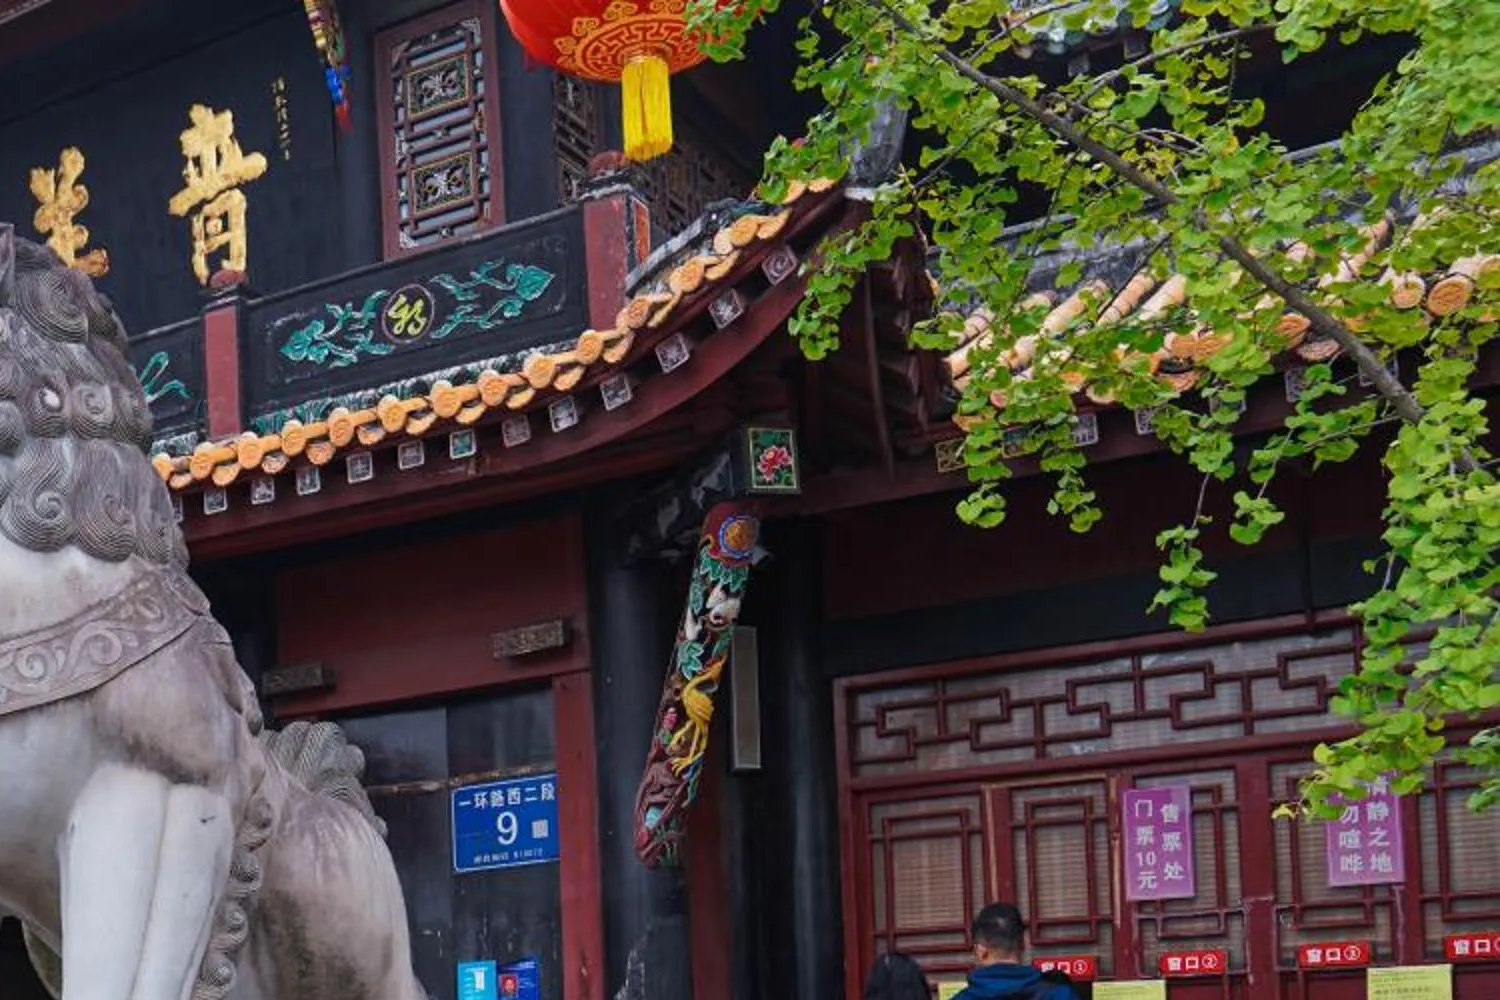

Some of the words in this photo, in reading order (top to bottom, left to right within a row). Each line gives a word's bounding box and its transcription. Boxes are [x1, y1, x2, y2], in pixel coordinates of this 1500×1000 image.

[458, 782, 556, 809] 一环路西二段
[496, 811, 518, 846] 9
[1134, 799, 1158, 890] 门票10元
[1160, 802, 1186, 881] 售票处
[1339, 803, 1364, 874] 勿喧哗
